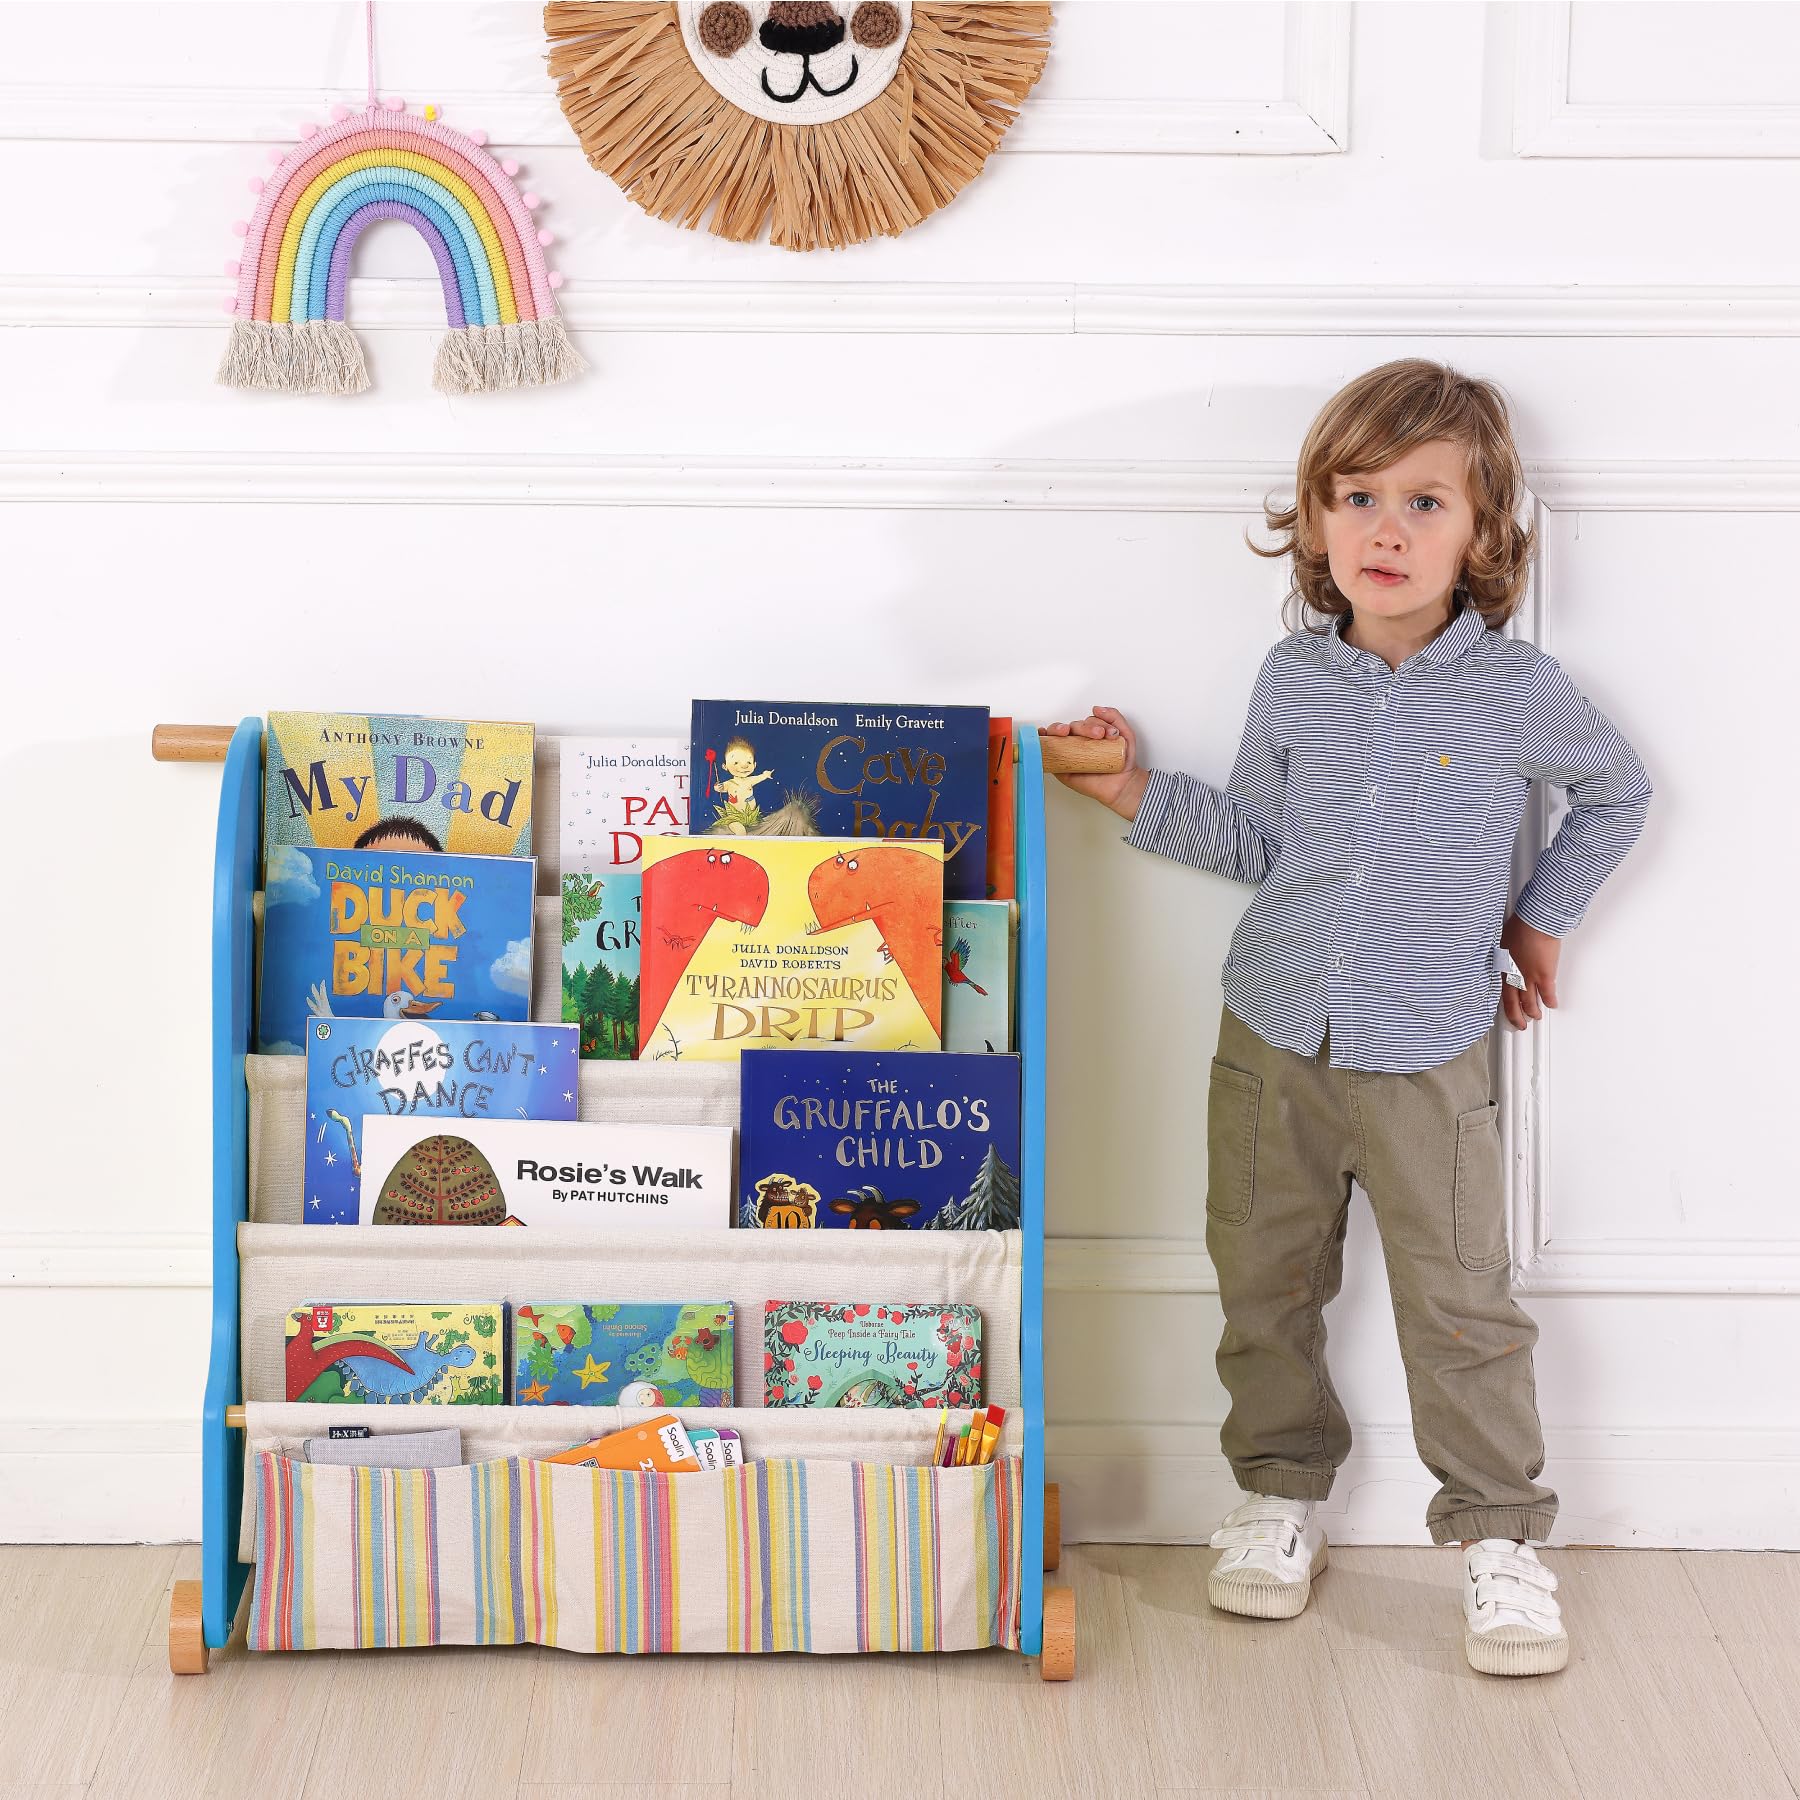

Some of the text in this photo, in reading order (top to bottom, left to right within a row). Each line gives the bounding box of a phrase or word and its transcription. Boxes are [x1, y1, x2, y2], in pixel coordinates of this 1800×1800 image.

[734, 710, 945, 732] Julia Donaldson Emily Gravett
[319, 728, 486, 750] ANTHONY BROWNE
[586, 754, 687, 770] Julia Donaldson
[815, 735, 947, 796] Cave
[279, 754, 523, 828] My Dad
[673, 774, 690, 790] T
[620, 795, 690, 827] PA
[325, 862, 475, 889] David Shannon
[329, 881, 468, 940] DUCK
[371, 928, 423, 945] ON A
[595, 919, 642, 951] GR
[731, 943, 849, 956] JULIA DONALDSON
[331, 939, 459, 999] BIKE
[740, 958, 841, 970] DAVID ROBERTS
[685, 973, 899, 1002] TYRANNOSAURUS
[710, 1003, 876, 1042] DRIP
[329, 1039, 536, 1089] GIRAFFES CAN'T
[377, 1079, 495, 1118] DANCE
[867, 1078, 899, 1094] THE
[773, 1094, 991, 1133] GRUFFALO'S
[835, 1135, 943, 1169] CHILD
[516, 1158, 703, 1190] Rosie's Walk
[552, 1189, 669, 1206] By PAT HUTCHINS
[772, 1210, 802, 1229] 10
[828, 1328, 846, 1340] Peep
[847, 1328, 871, 1339] Inside
[878, 1328, 899, 1340] Fairy
[899, 1329, 916, 1339] Tale
[859, 1320, 884, 1328] Usborne
[803, 1339, 939, 1369] Sleeping Beauty
